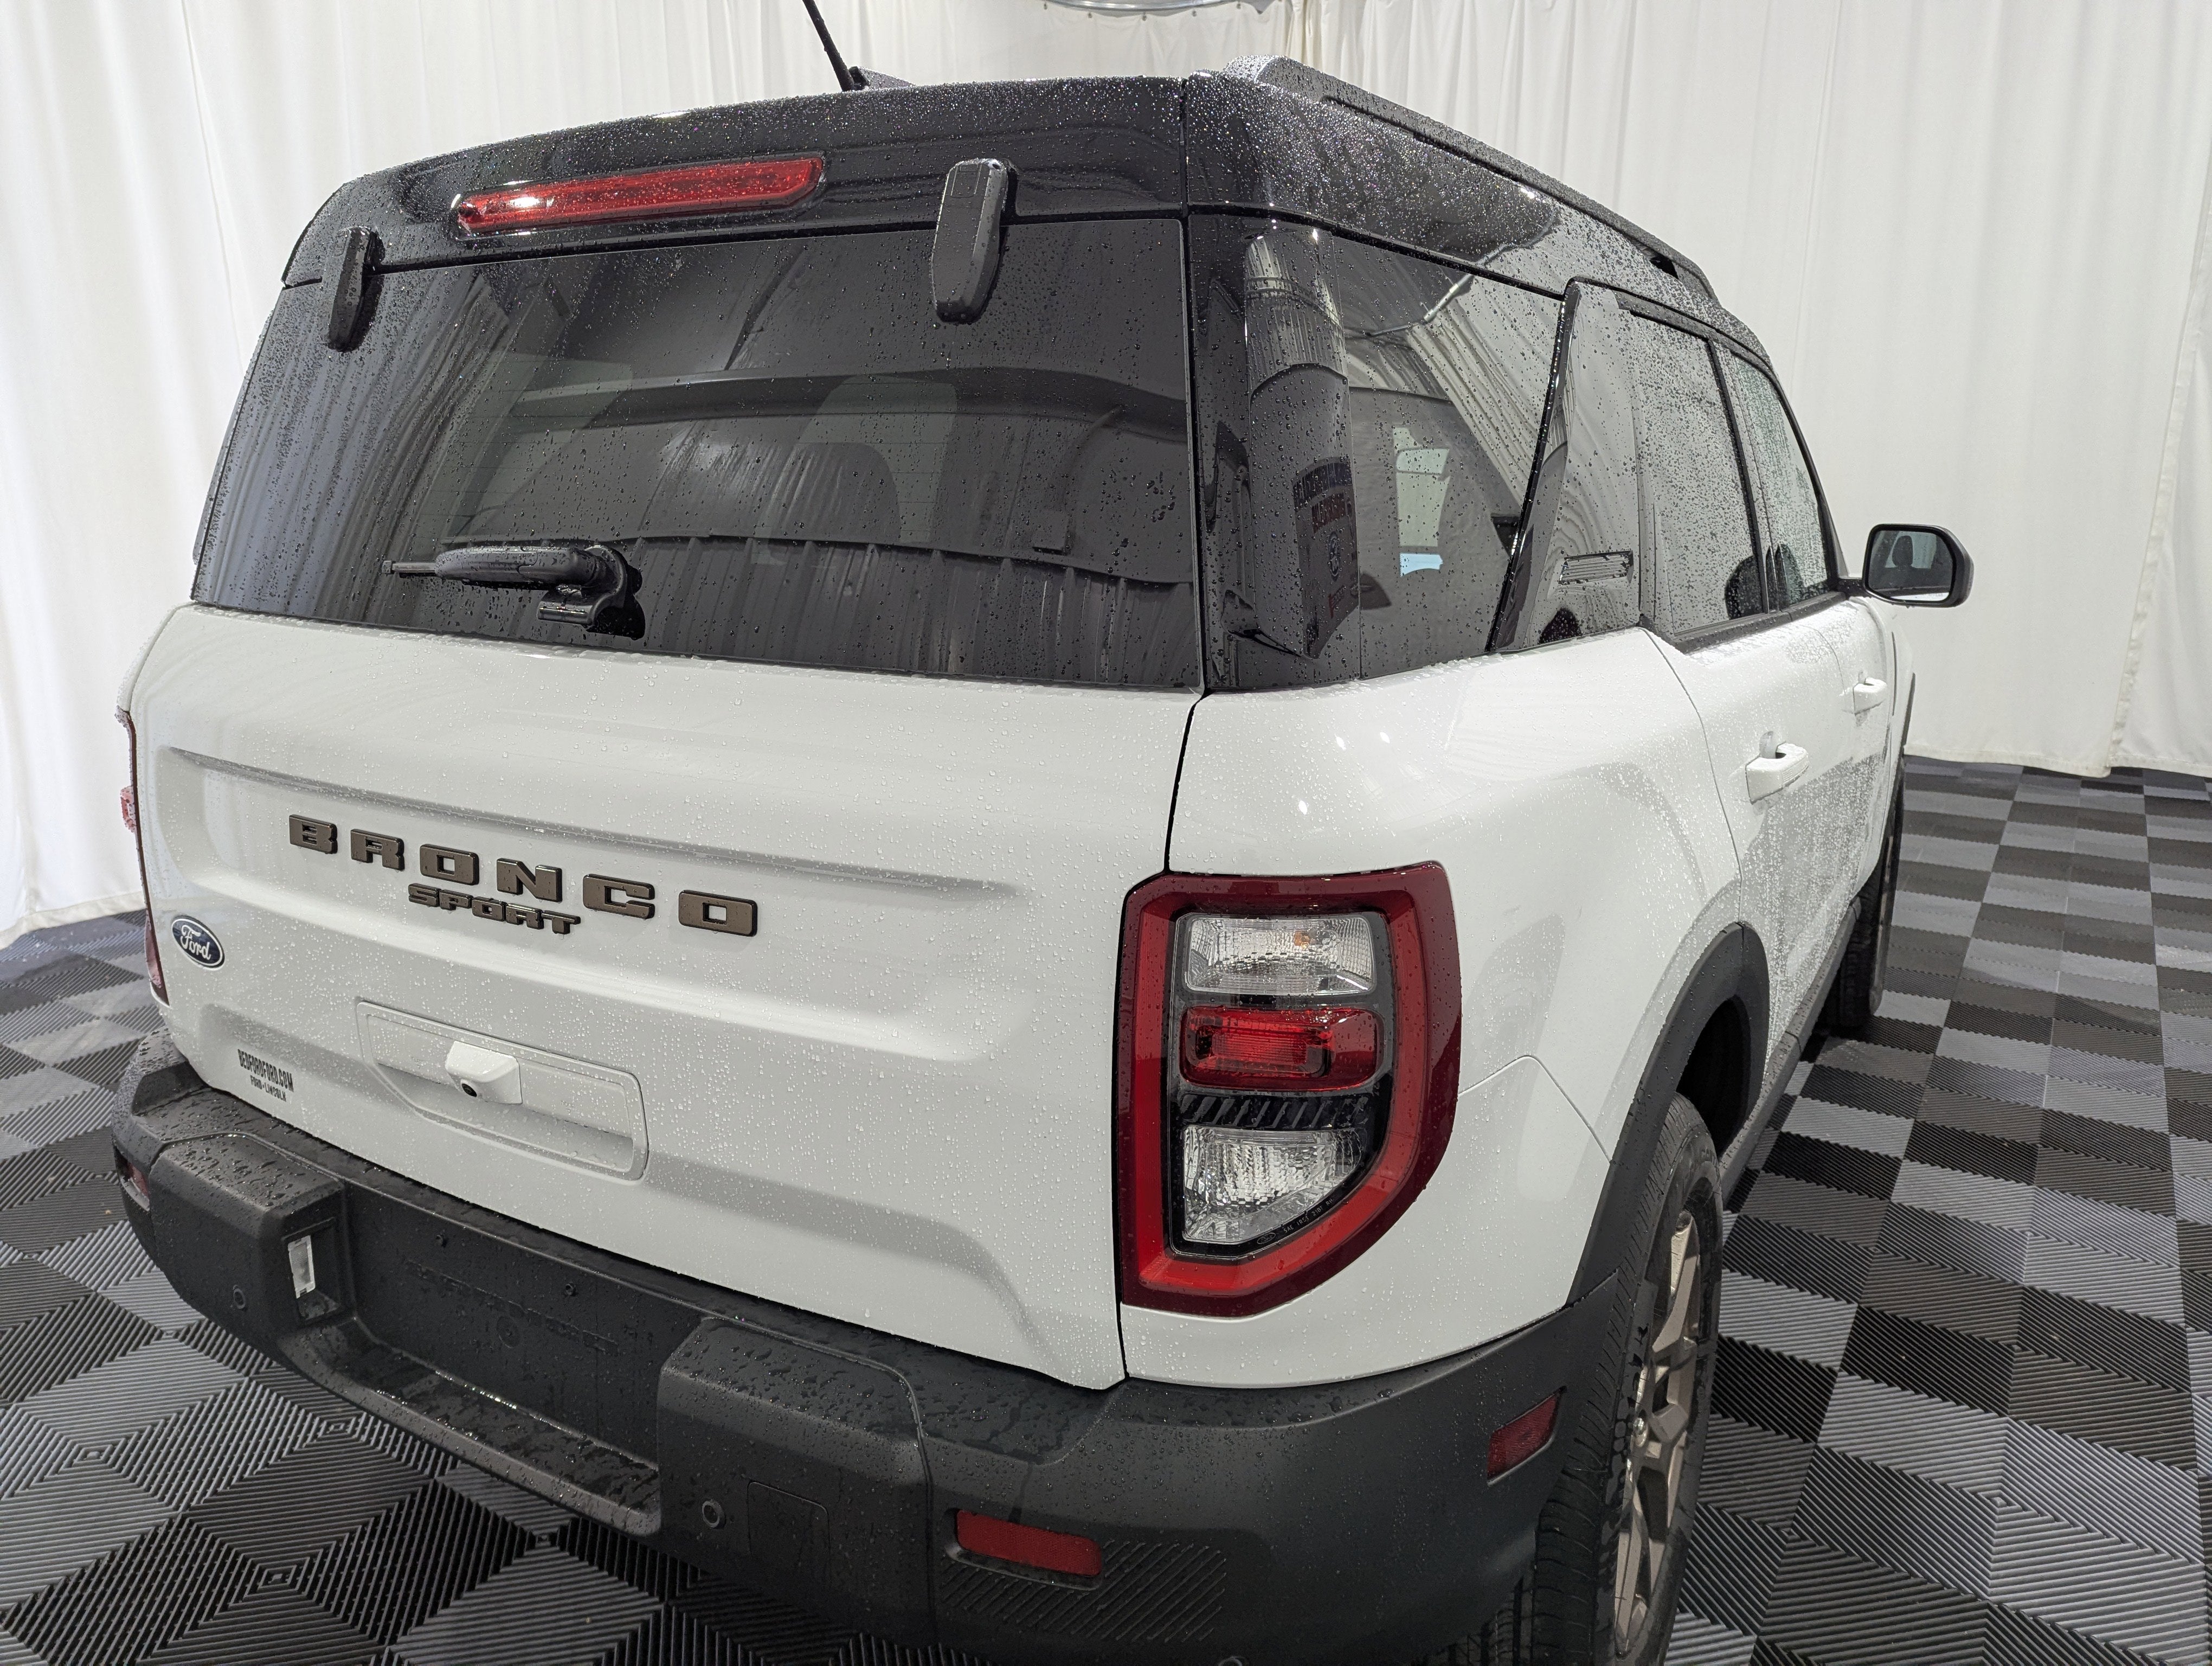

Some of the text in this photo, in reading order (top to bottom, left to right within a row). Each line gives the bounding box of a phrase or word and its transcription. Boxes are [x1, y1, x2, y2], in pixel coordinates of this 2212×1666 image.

[288, 813, 758, 937] BRONCO
[408, 882, 581, 934] SPORT
[180, 924, 211, 960] Ford
[237, 1048, 294, 1092] BEDFORDFORD.COM
[1283, 1224, 1294, 1233] SAE
[1326, 1198, 1334, 1206] RH
